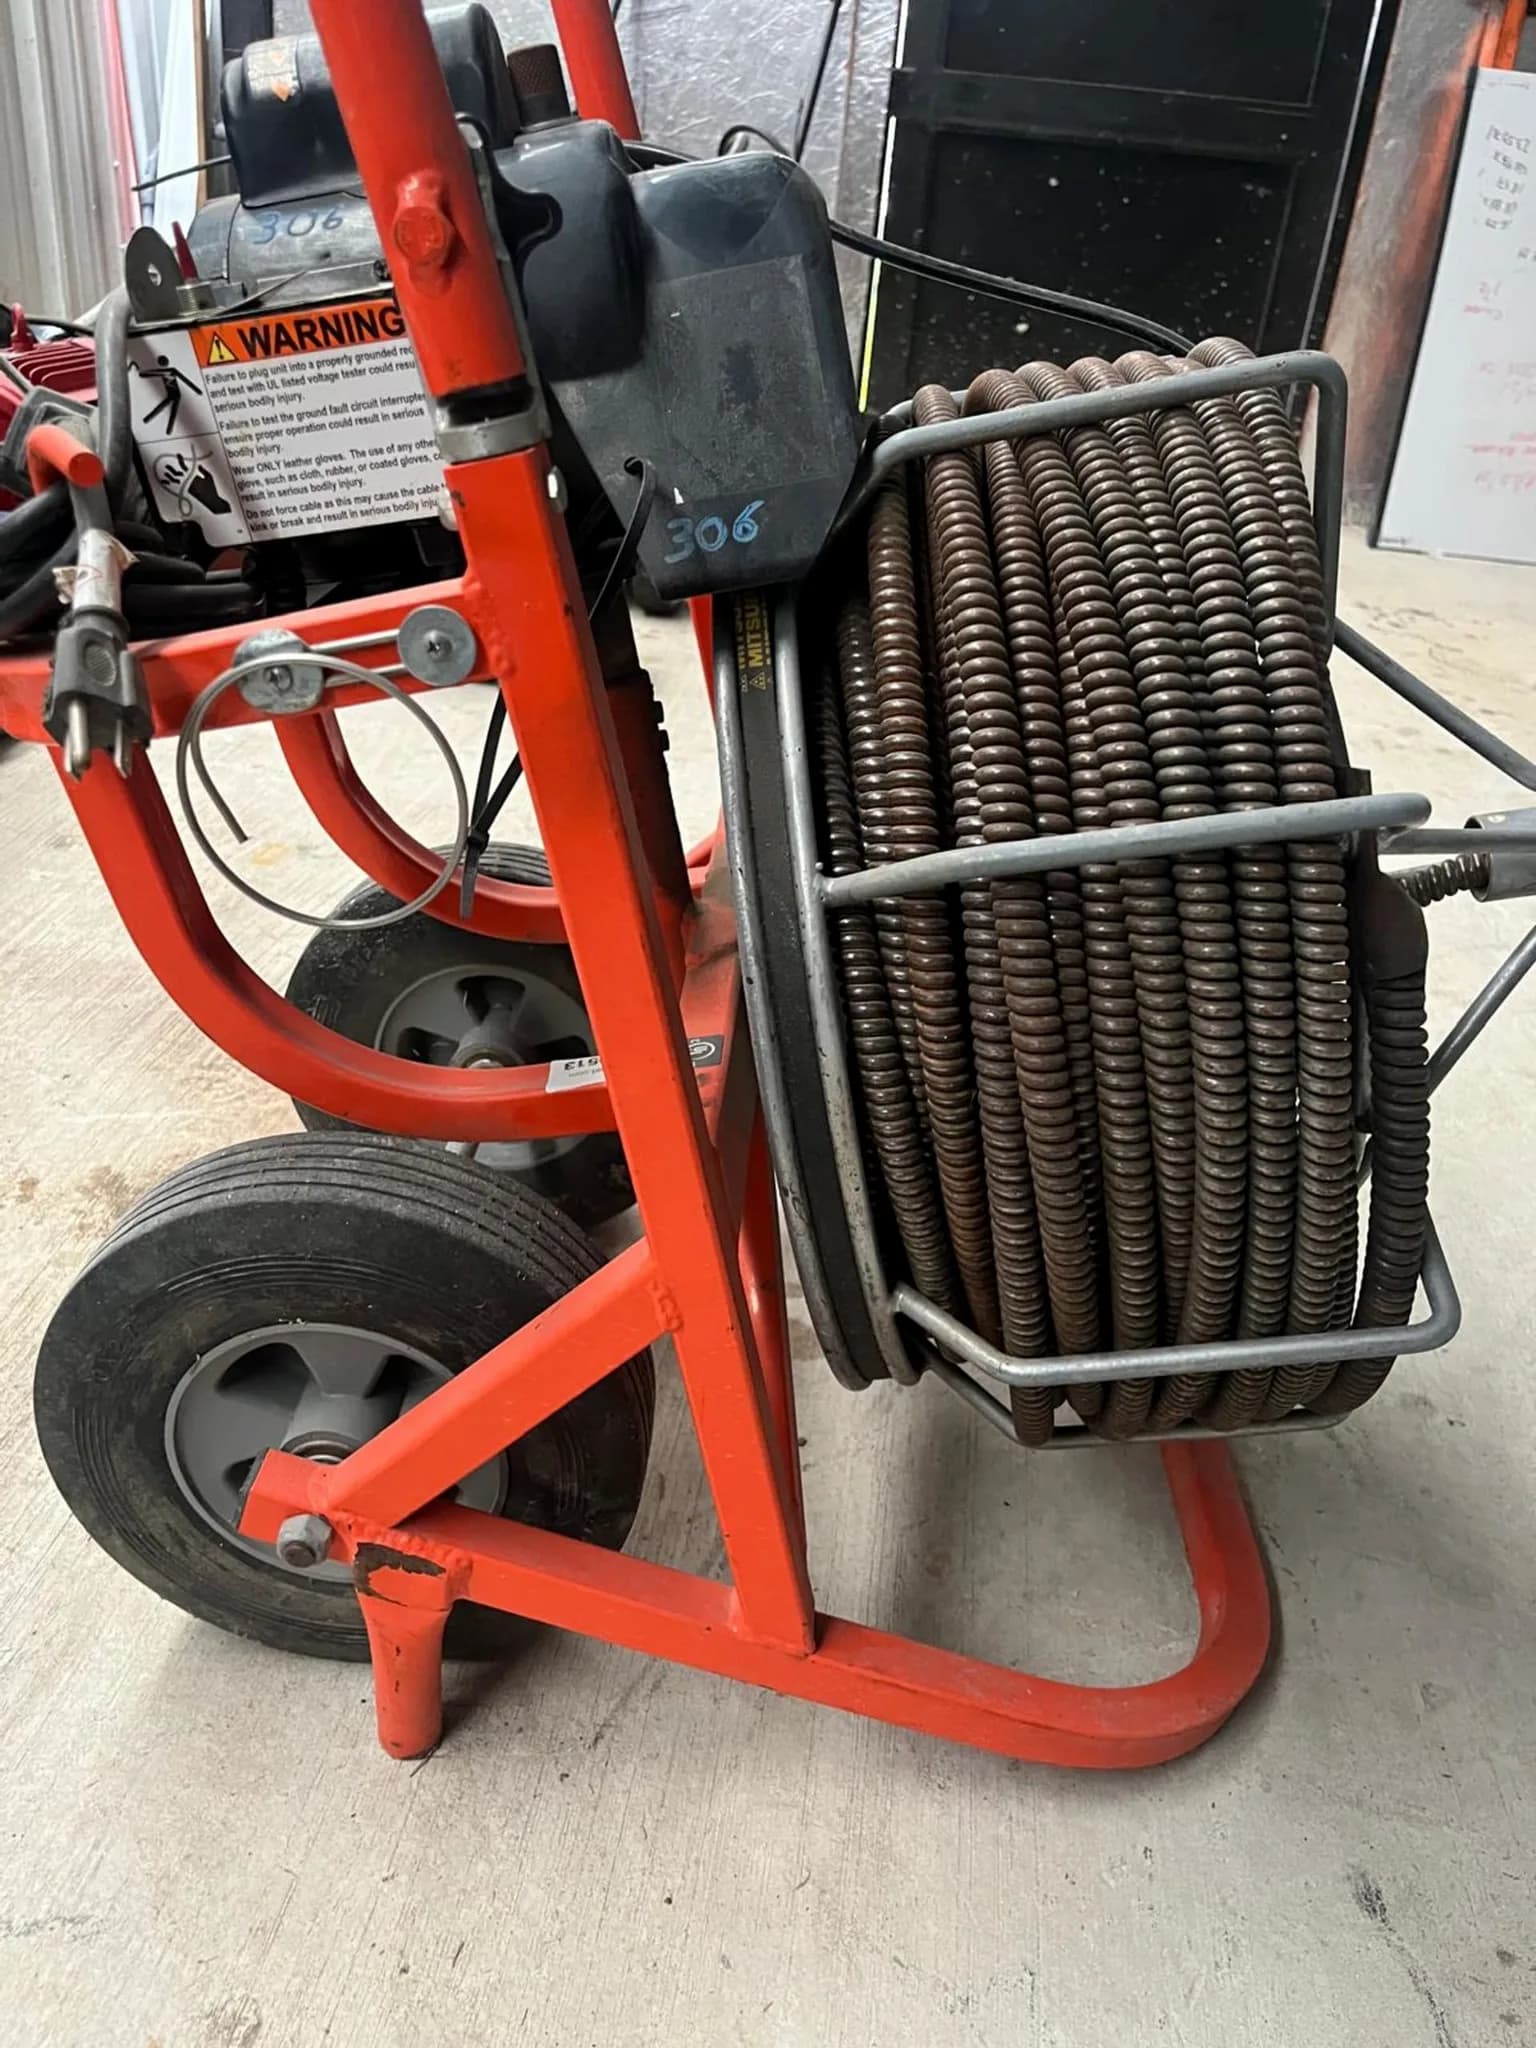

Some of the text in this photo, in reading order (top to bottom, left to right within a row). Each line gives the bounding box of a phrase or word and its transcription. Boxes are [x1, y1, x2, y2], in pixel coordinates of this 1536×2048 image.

[252, 206, 345, 244] 306
[237, 306, 406, 358] WARNING
[205, 372, 236, 385] Failure
[237, 370, 248, 378] to
[248, 367, 270, 381] plug
[270, 363, 288, 374] unit
[289, 361, 308, 372] into
[315, 353, 353, 369] properly
[355, 346, 398, 363] grounded
[209, 386, 226, 398] and
[227, 384, 245, 395] test
[246, 381, 266, 393] with
[266, 379, 280, 391] UL
[280, 375, 306, 388] listed
[307, 371, 340, 384] voltage
[340, 367, 366, 379] tester
[368, 362, 393, 375] could
[213, 391, 306, 414] serious bodily injury.
[219, 420, 250, 432] Failure
[250, 417, 261, 426] to
[261, 413, 279, 425] test
[279, 412, 295, 422] the
[295, 404, 328, 423] ground
[328, 402, 350, 415] fault
[350, 397, 379, 413] circuit
[223, 406, 425, 445] ensure proper operation could result in serious
[227, 443, 284, 458] bodily injury.
[231, 465, 255, 476] Wear
[256, 460, 281, 473] ONLY
[283, 457, 313, 468] leather
[314, 453, 346, 467] gloves.
[349, 448, 367, 460] The
[367, 447, 385, 457] use
[385, 442, 395, 454] of
[397, 442, 413, 454] any
[264, 474, 286, 485] such
[287, 473, 297, 482] as
[357, 463, 367, 473] or
[368, 457, 398, 471] coated
[241, 477, 366, 502] result in serious bodily injury.
[245, 509, 259, 520] Do
[260, 508, 274, 518] not
[275, 504, 298, 516] force
[299, 500, 322, 513] cable
[324, 499, 334, 509] as
[336, 496, 353, 508] this
[353, 494, 372, 506] may
[373, 489, 399, 502] cause
[400, 487, 416, 497] the
[416, 482, 441, 496] cable
[248, 521, 268, 533] kink
[269, 520, 279, 531] or
[280, 516, 305, 529] break
[306, 513, 323, 525] and
[323, 509, 349, 523] result
[349, 508, 359, 519] in
[359, 503, 392, 517] serious
[392, 500, 420, 514] bodily
[664, 499, 765, 564] 306
